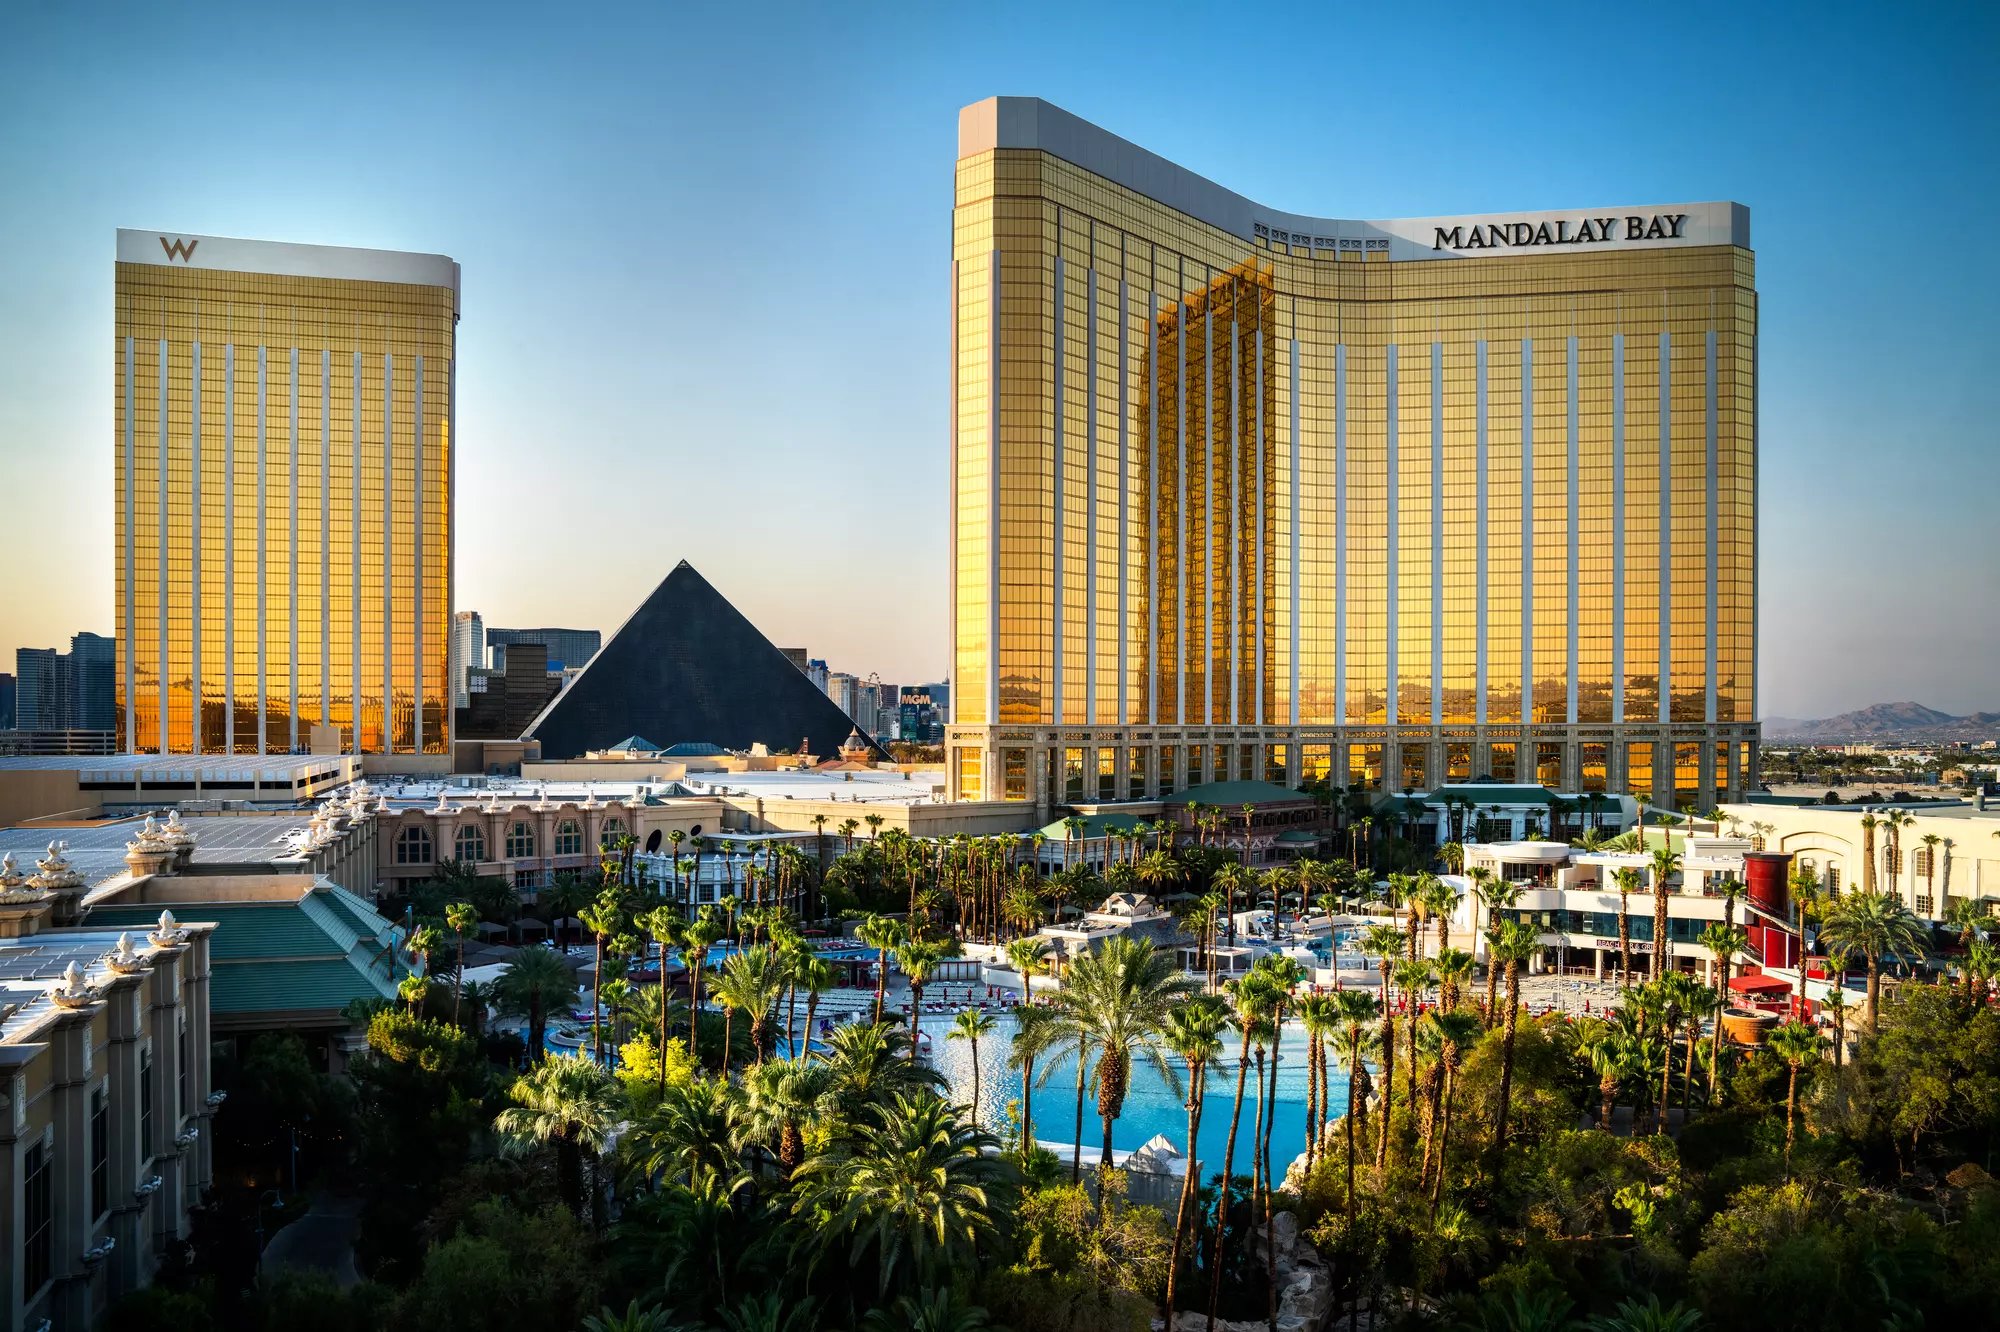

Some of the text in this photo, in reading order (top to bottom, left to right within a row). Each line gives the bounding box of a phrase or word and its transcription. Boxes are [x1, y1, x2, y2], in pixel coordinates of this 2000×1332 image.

[1432, 215, 1685, 250] MANDALAY BAY
[159, 236, 199, 263] W
[901, 694, 931, 705] MGM
[1597, 940, 1620, 948] BEACH
